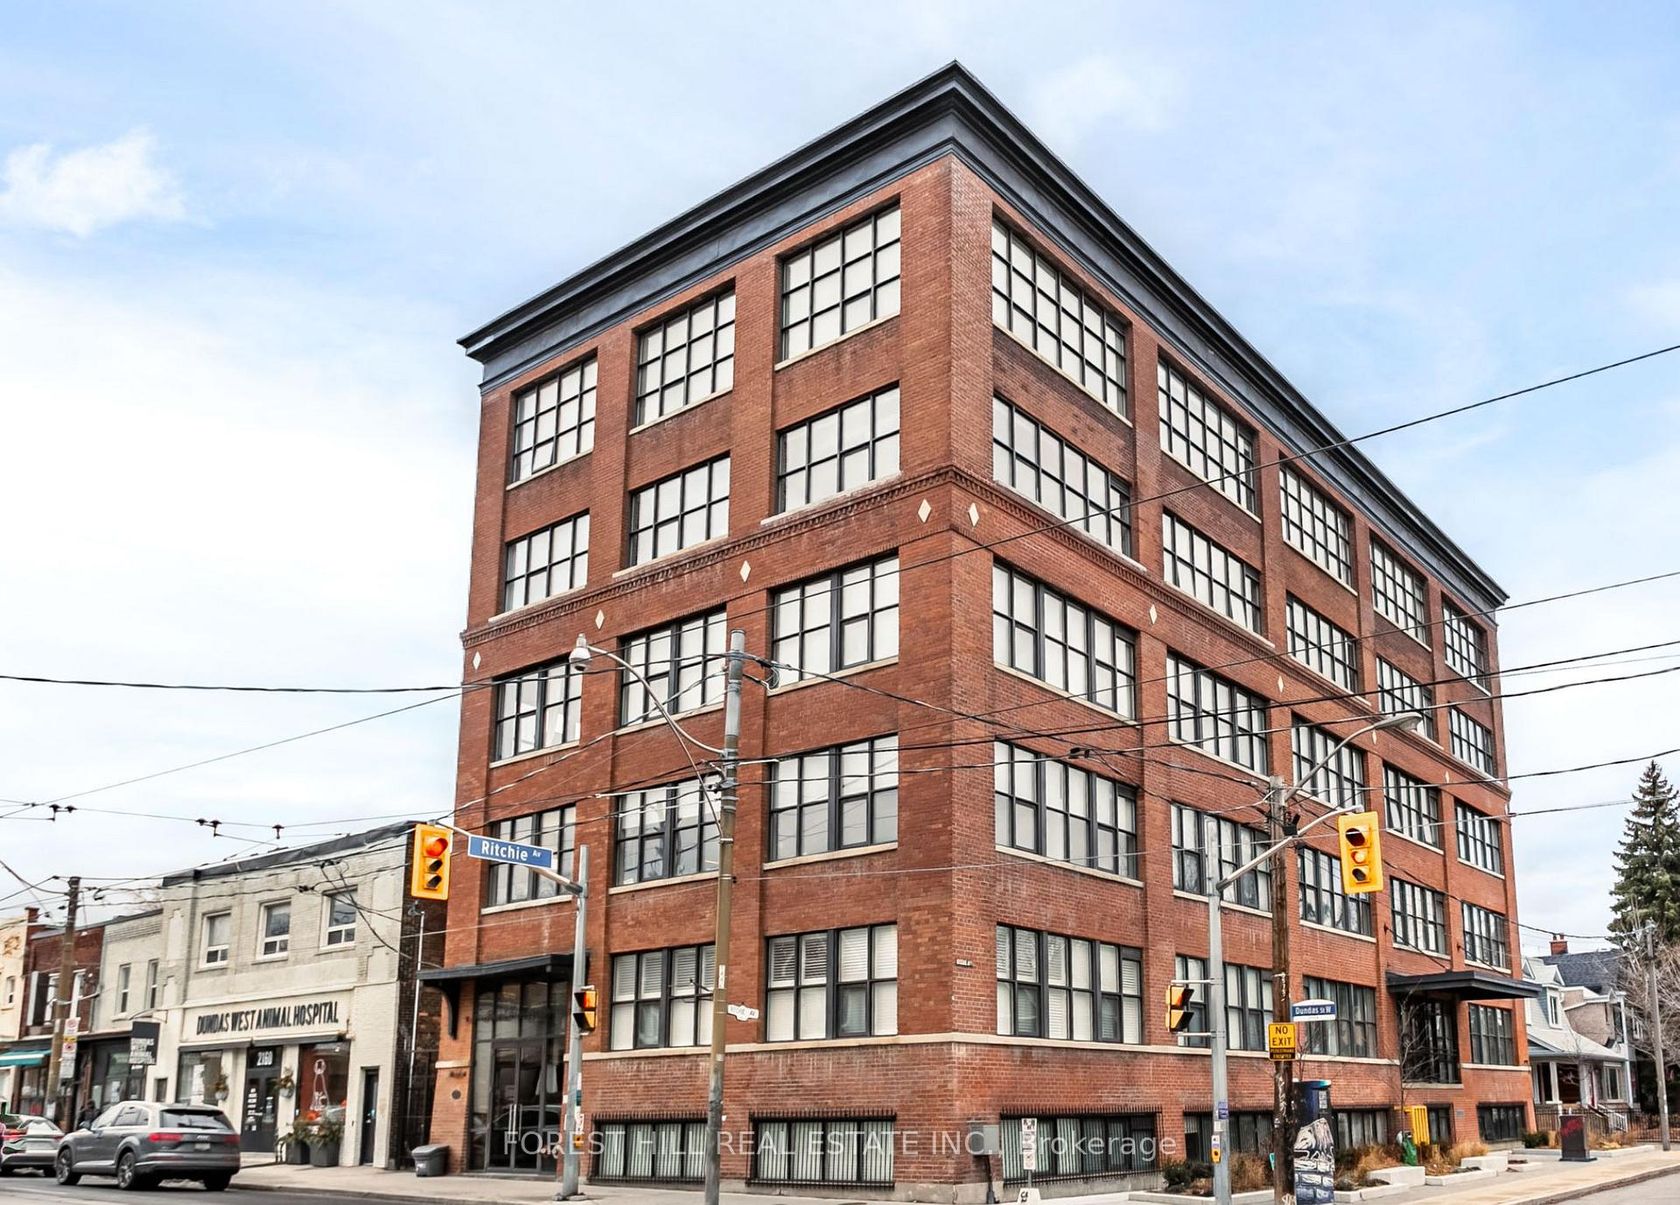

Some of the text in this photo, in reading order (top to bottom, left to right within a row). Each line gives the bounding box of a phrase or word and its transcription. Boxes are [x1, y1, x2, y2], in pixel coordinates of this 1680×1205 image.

[481, 840, 528, 861] Ritchie
[1295, 1006, 1319, 1015] Dundas
[196, 1001, 339, 1035] DUNDAS WEST ANIMAL HOSPITAL
[1275, 1026, 1288, 1034] NO
[1272, 1037, 1292, 1046] EXIT
[256, 1051, 273, 1066] 2160
